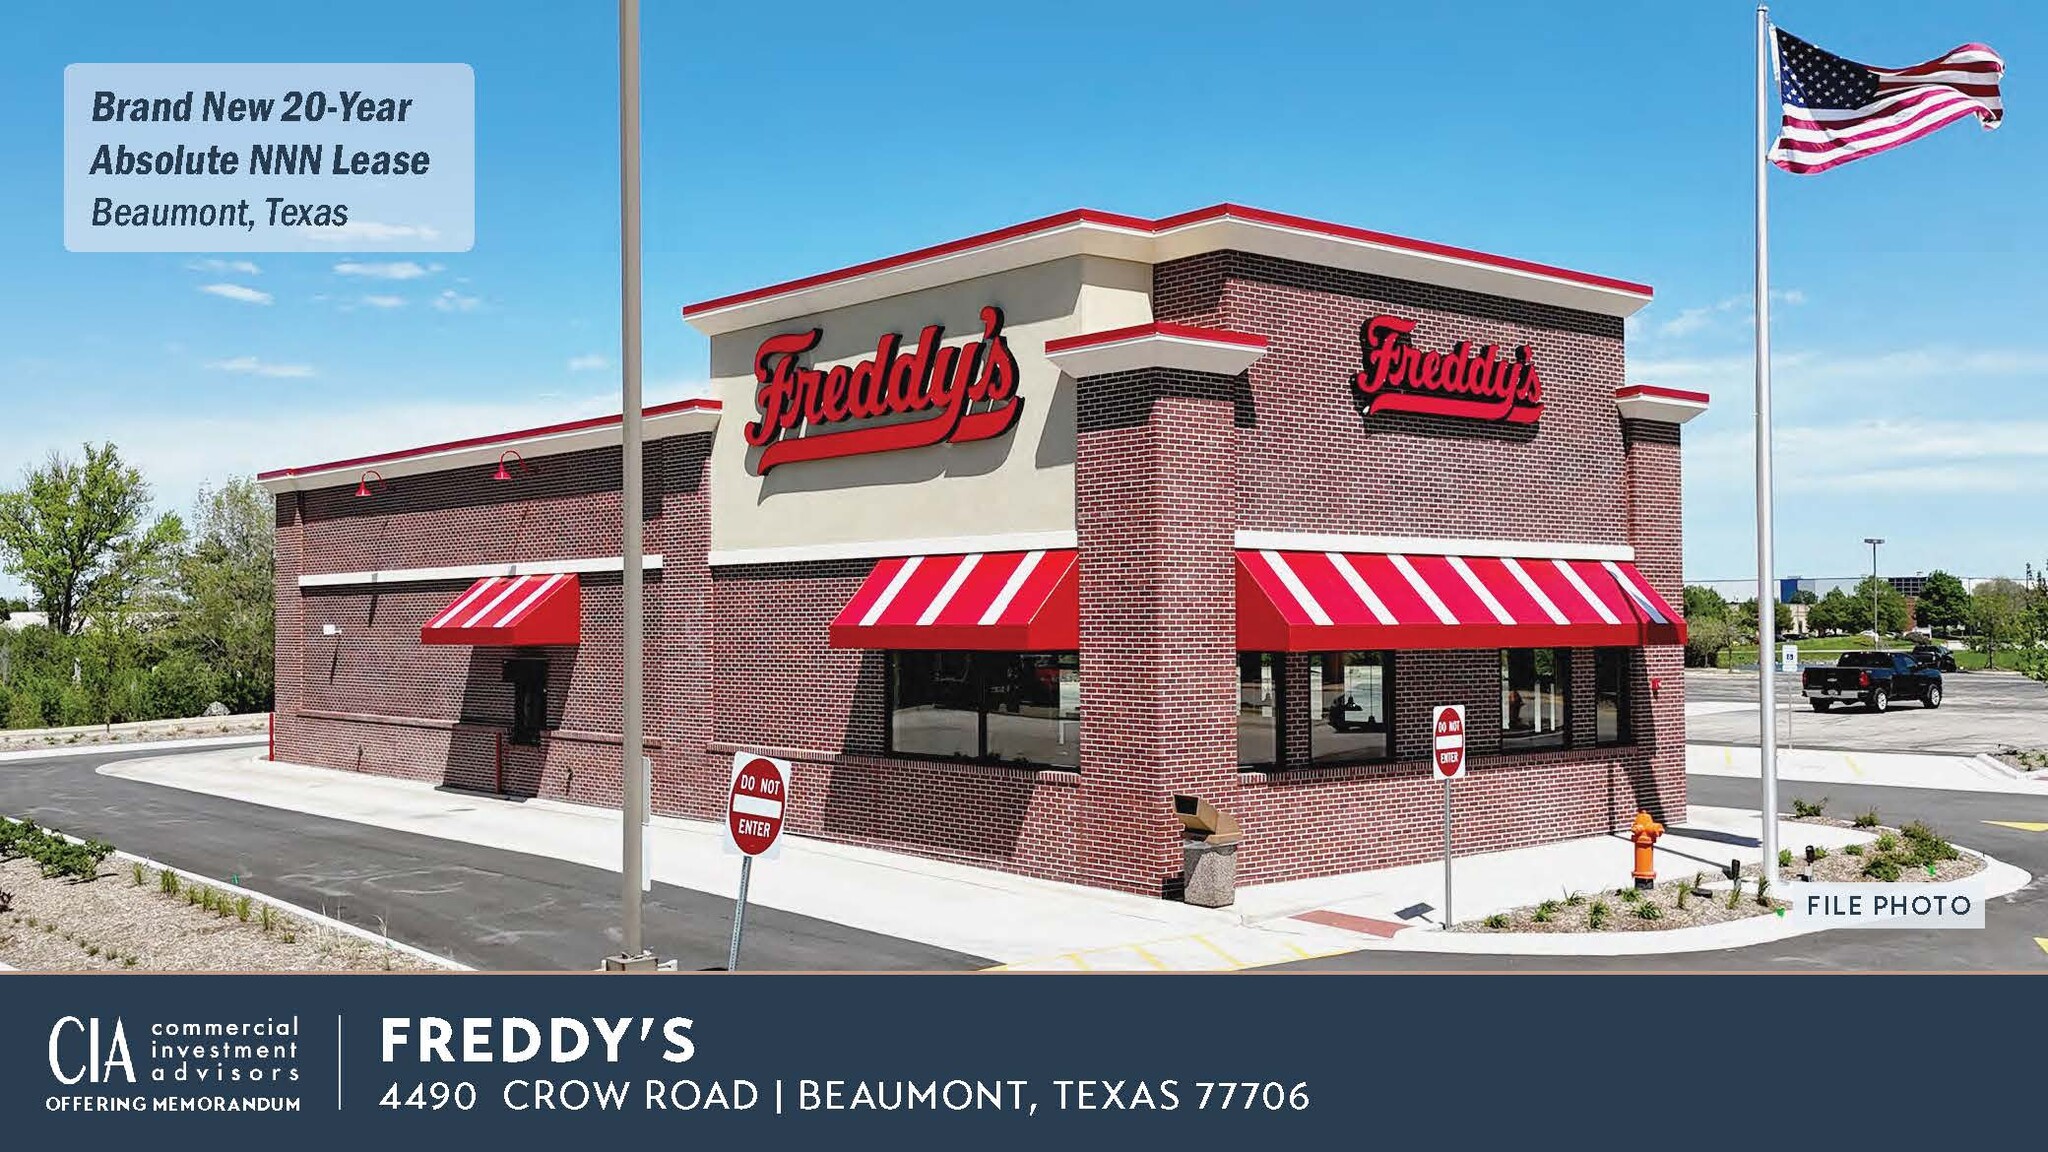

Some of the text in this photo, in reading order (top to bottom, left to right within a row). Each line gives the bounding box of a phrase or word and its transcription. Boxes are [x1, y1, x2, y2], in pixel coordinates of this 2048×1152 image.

[1356, 314, 1546, 424] Freddy's
[744, 305, 1025, 476] Freddy's
[1438, 720, 1460, 733] DO NOT
[1440, 751, 1459, 764] ENTER
[740, 774, 780, 795] DO NOT
[738, 818, 771, 837] ENTER
